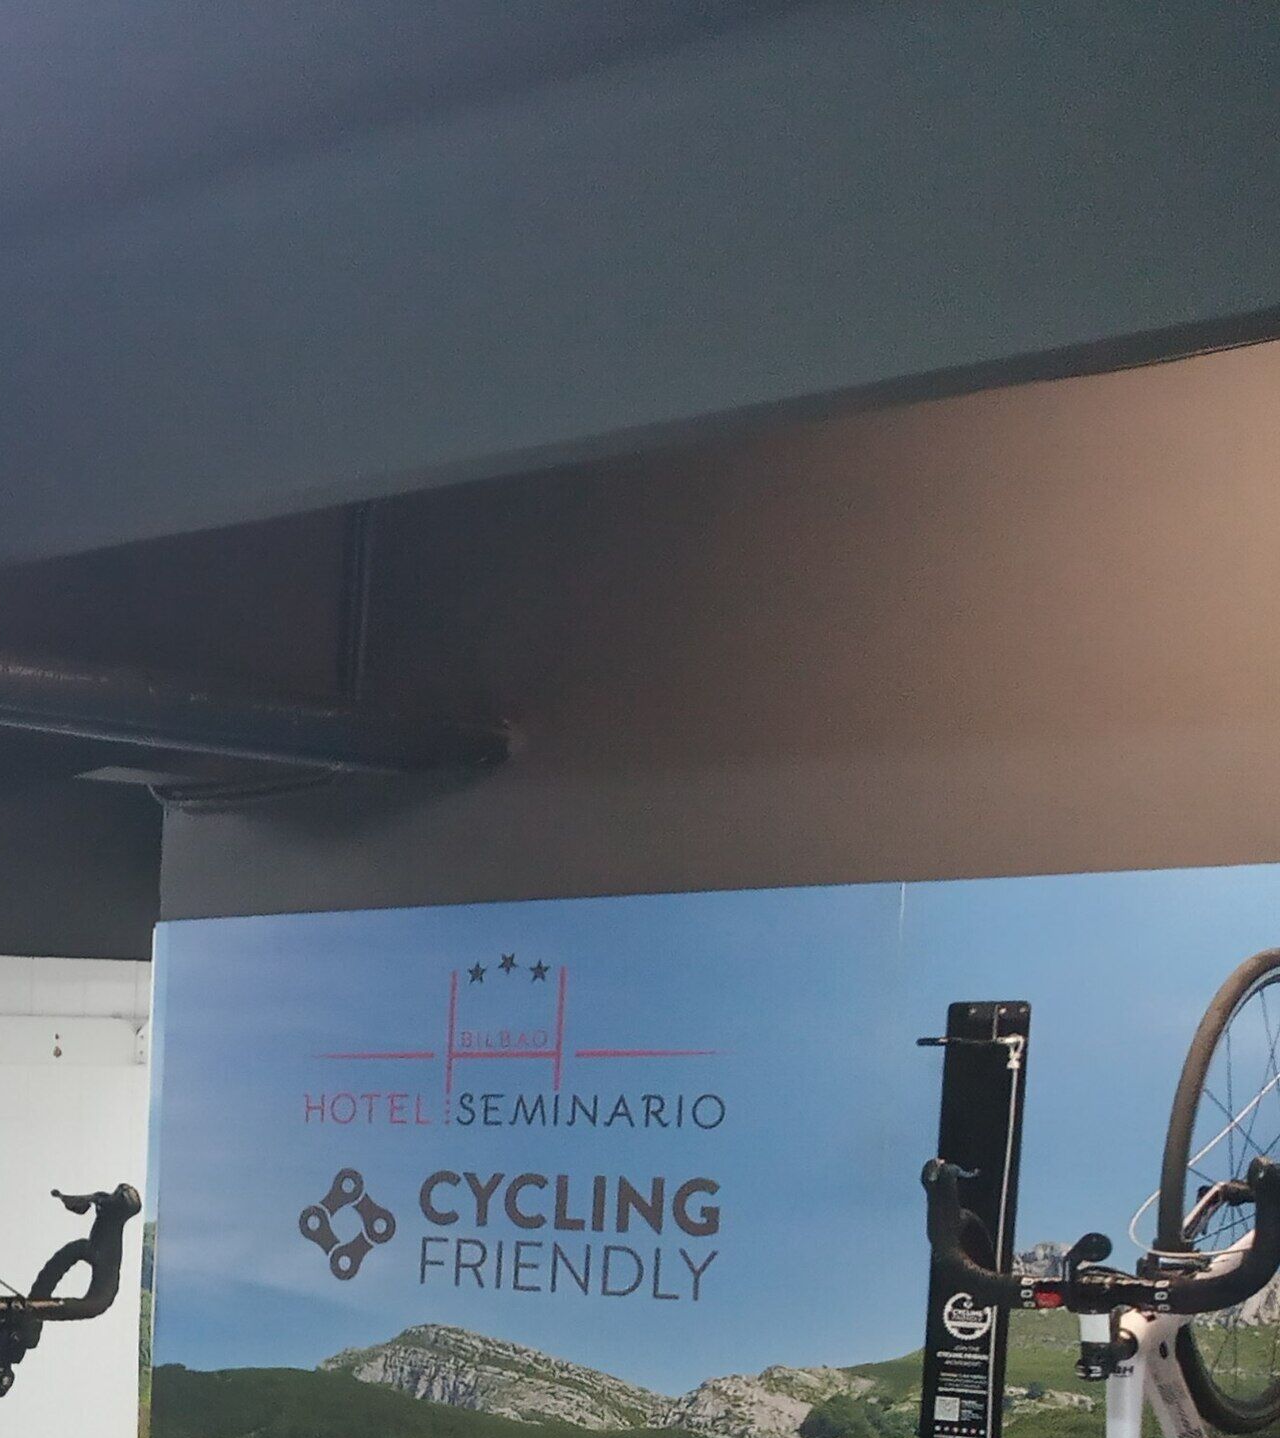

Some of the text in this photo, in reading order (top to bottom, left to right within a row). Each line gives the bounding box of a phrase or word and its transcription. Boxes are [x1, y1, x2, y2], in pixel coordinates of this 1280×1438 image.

[460, 1030, 549, 1049] BILBAO
[304, 1093, 726, 1129] HOTEL SEMINARIO
[419, 1170, 721, 1237] CYCLING
[419, 1237, 719, 1301] FRIENDLY
